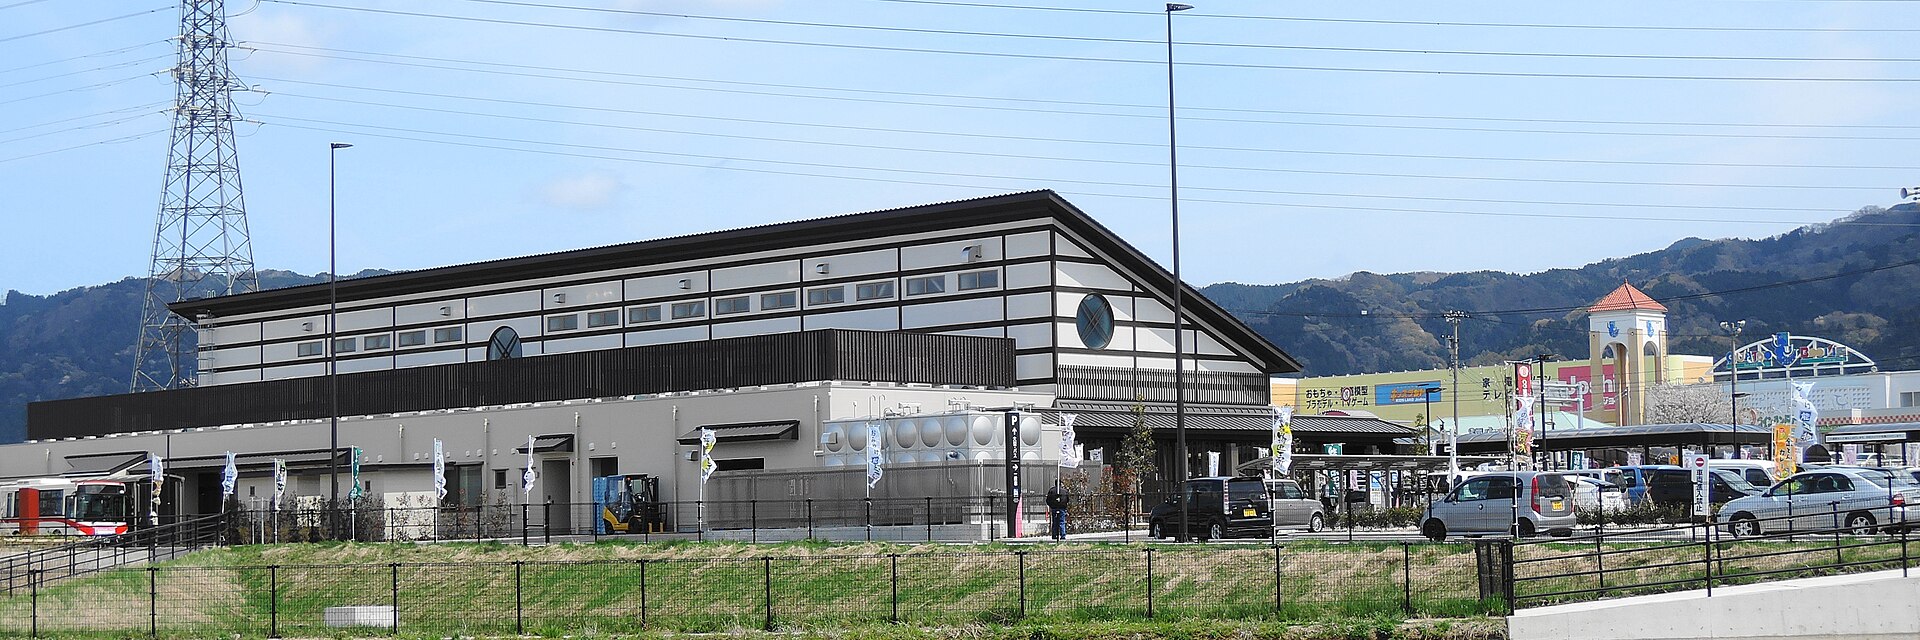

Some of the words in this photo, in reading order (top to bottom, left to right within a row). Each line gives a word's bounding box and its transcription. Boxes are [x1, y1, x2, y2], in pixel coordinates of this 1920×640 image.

[1306, 386, 1368, 399] おもちゃ・道模型
[1306, 397, 1368, 409] プラモデル・TVゲーム
[1011, 415, 1018, 425] P
[1695, 469, 1703, 512] 車両進入禁止
